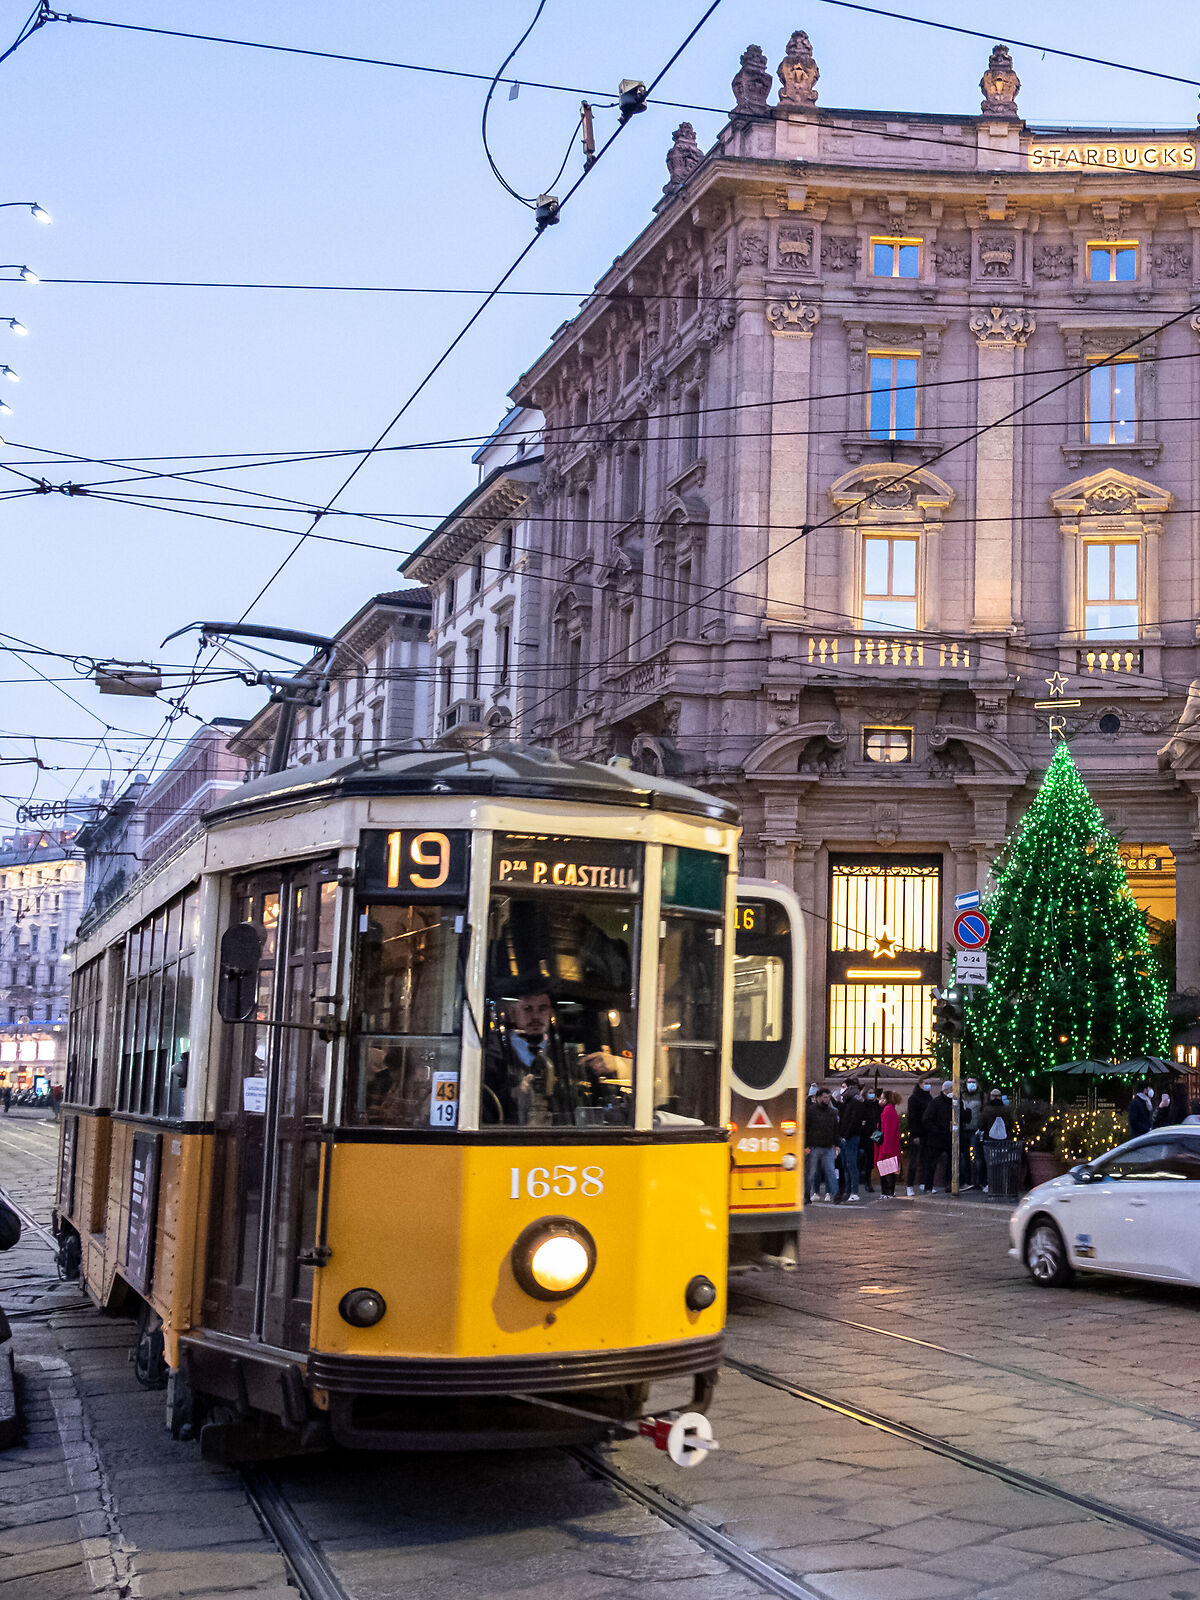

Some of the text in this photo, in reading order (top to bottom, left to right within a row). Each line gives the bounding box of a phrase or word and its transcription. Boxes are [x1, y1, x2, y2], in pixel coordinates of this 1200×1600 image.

[1032, 148, 1194, 165] STARBUCKS
[387, 831, 451, 889] 19
[436, 1082, 455, 1101] 43
[436, 1104, 454, 1122] 19
[737, 1137, 780, 1153] 4916
[509, 1164, 605, 1200] 1658
